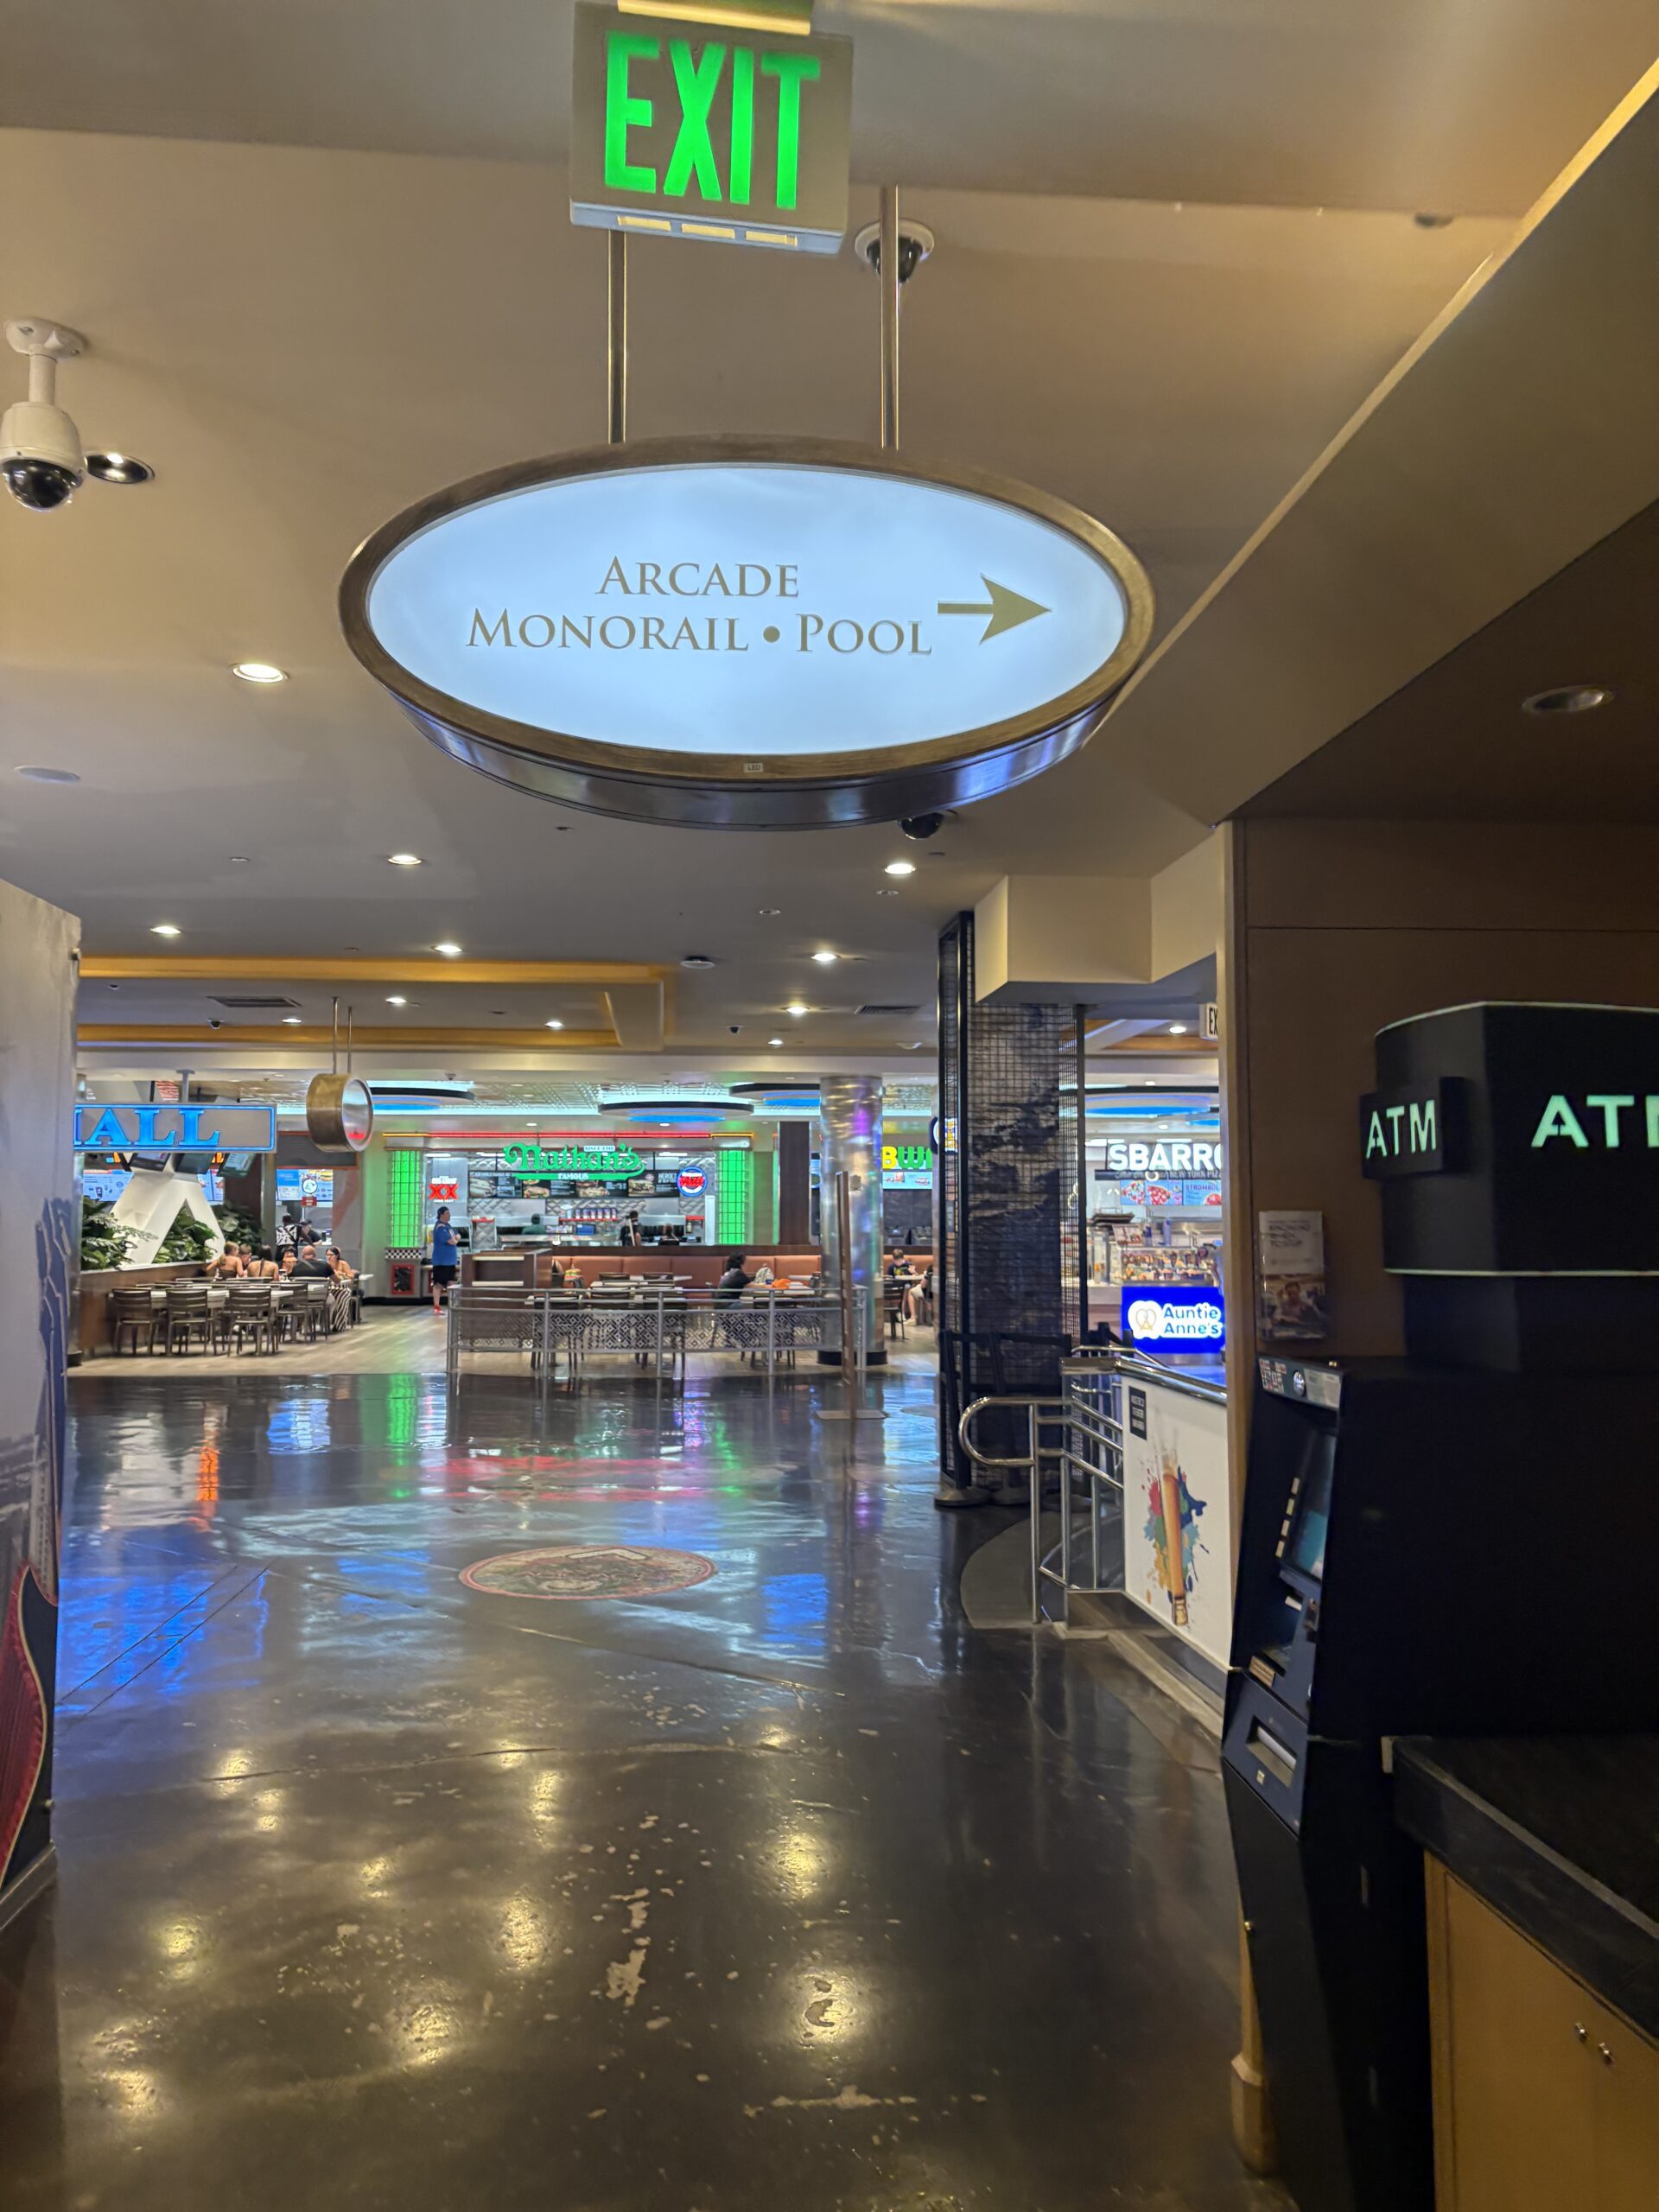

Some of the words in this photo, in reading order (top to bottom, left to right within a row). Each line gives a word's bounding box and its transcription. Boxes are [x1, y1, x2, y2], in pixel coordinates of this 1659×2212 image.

[604, 29, 821, 210] EXIT
[594, 556, 799, 598] ARCADE
[466, 607, 749, 652] MONORAIL
[795, 613, 932, 656] POOL
[1366, 1099, 1437, 1160] ATM
[503, 1142, 643, 1171] Nathan's
[1164, 1305, 1218, 1319] Auntie
[1164, 1322, 1219, 1334] Anne's
